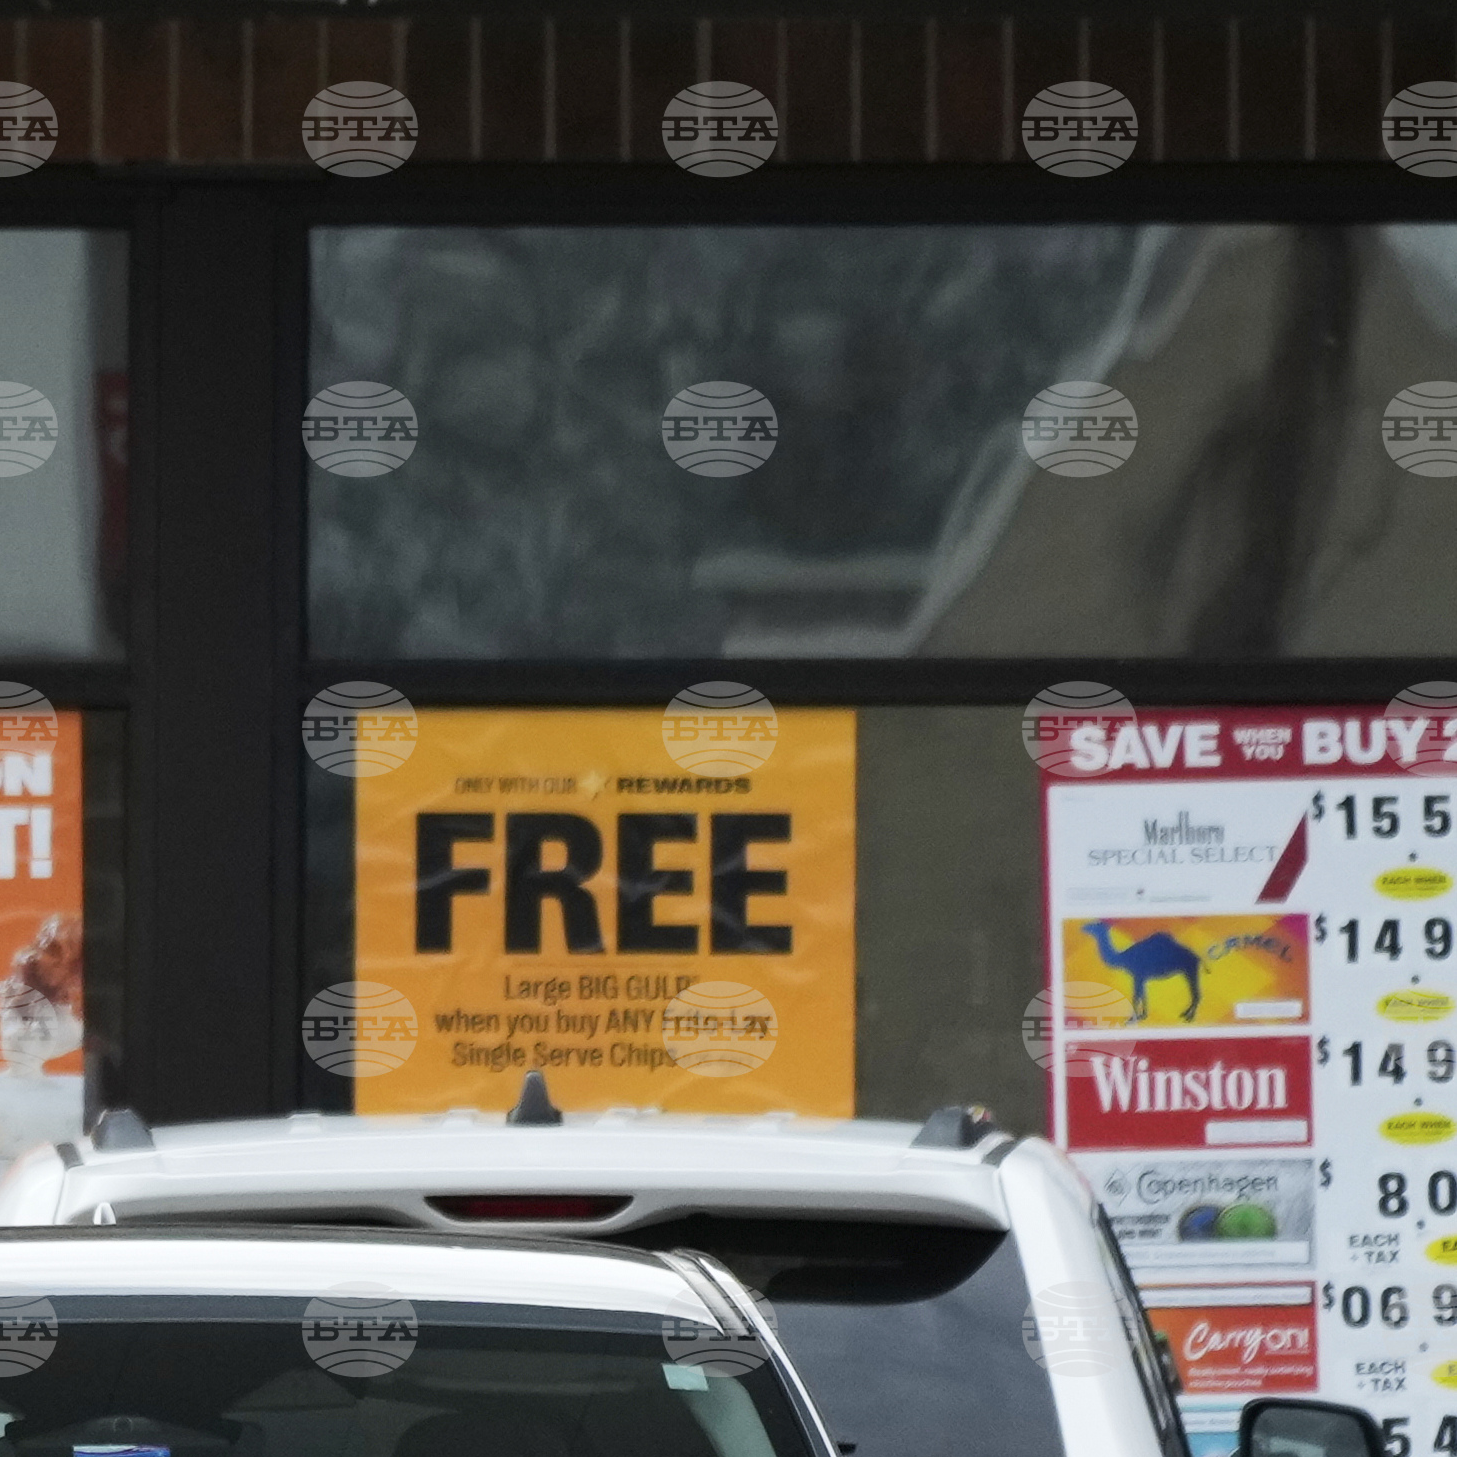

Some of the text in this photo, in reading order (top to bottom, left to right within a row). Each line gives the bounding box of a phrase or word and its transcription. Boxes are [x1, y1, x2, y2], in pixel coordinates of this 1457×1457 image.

[1069, 719, 1293, 771] SAVE WHEN
[1244, 742, 1284, 761] YOU
[1302, 717, 1430, 765] BUY
[616, 777, 752, 794] REWARDS
[1144, 810, 1226, 845] Marlboro
[1088, 845, 1278, 867] SPECIAL SELECT
[415, 812, 794, 955] FREE
[1207, 932, 1293, 963] CAMEL
[504, 975, 571, 1006] Large
[578, 975, 618, 1000] BIG
[435, 1009, 500, 1034] when
[506, 1016, 549, 1039] you
[557, 1009, 600, 1039] buy
[605, 1009, 654, 1034] ANY
[451, 1043, 526, 1073] Single
[533, 1044, 603, 1067] Serve
[610, 1043, 677, 1072] Chips
[1091, 1054, 1290, 1114] Winston
[1137, 1169, 1279, 1204] Copenhagen
[1348, 1233, 1400, 1248] EACH
[1364, 1250, 1400, 1264] TAX
[1355, 1361, 1406, 1375] EACH
[1371, 1377, 1407, 1391] TAX
